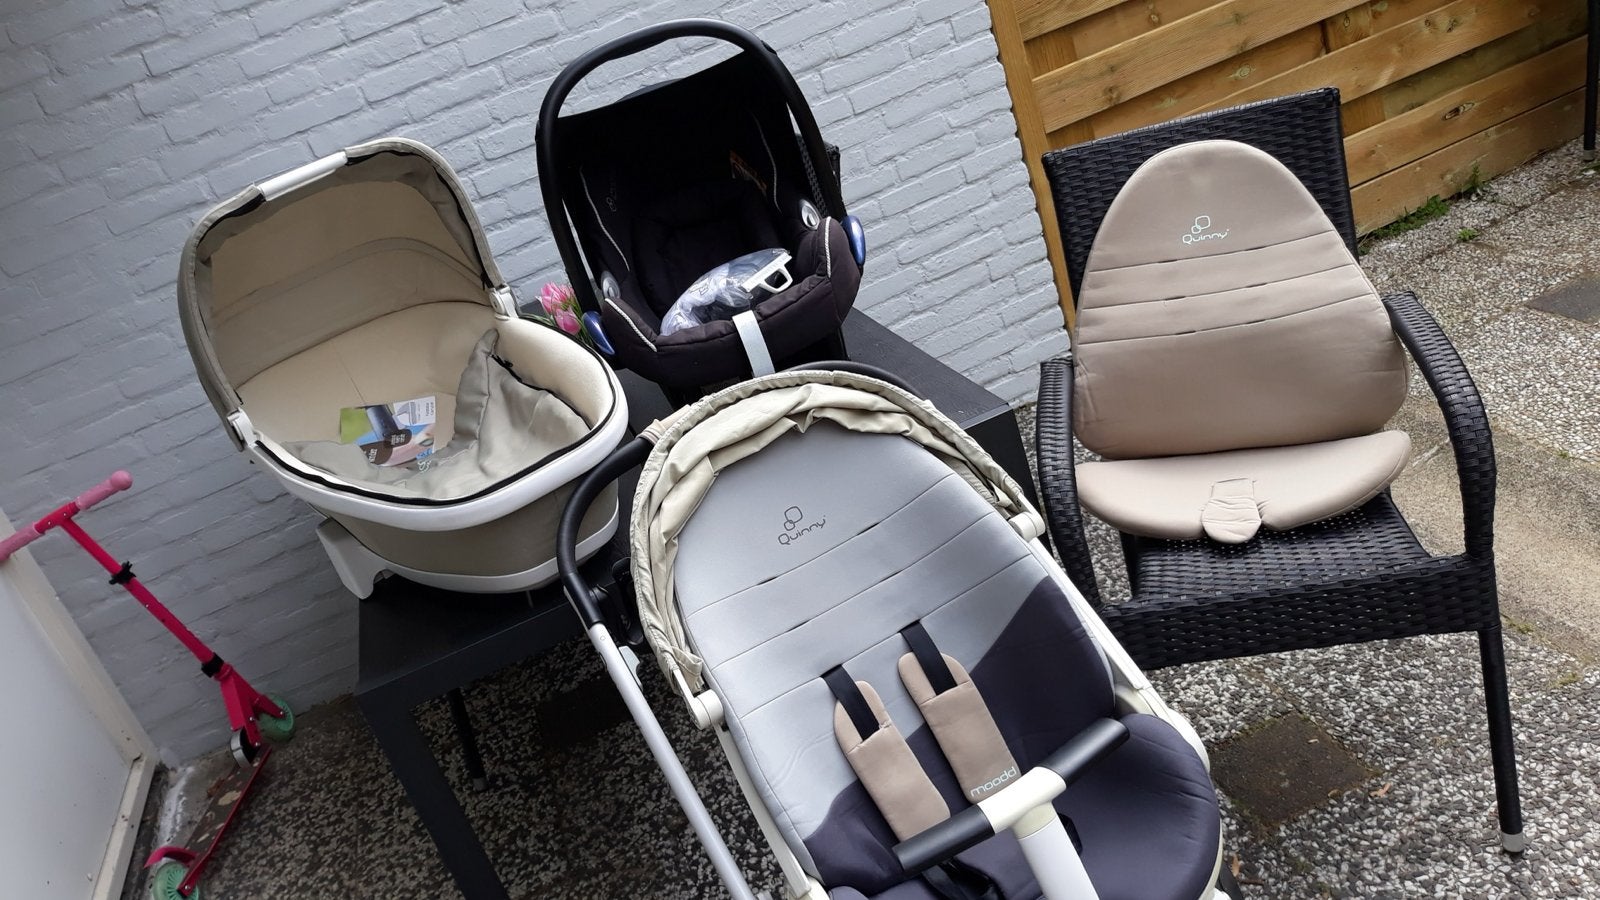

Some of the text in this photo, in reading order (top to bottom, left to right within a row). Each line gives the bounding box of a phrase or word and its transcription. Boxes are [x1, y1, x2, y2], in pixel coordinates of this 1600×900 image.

[1182, 231, 1228, 245] Quinny
[778, 518, 826, 545] Quinny
[970, 766, 1017, 797] moodd
